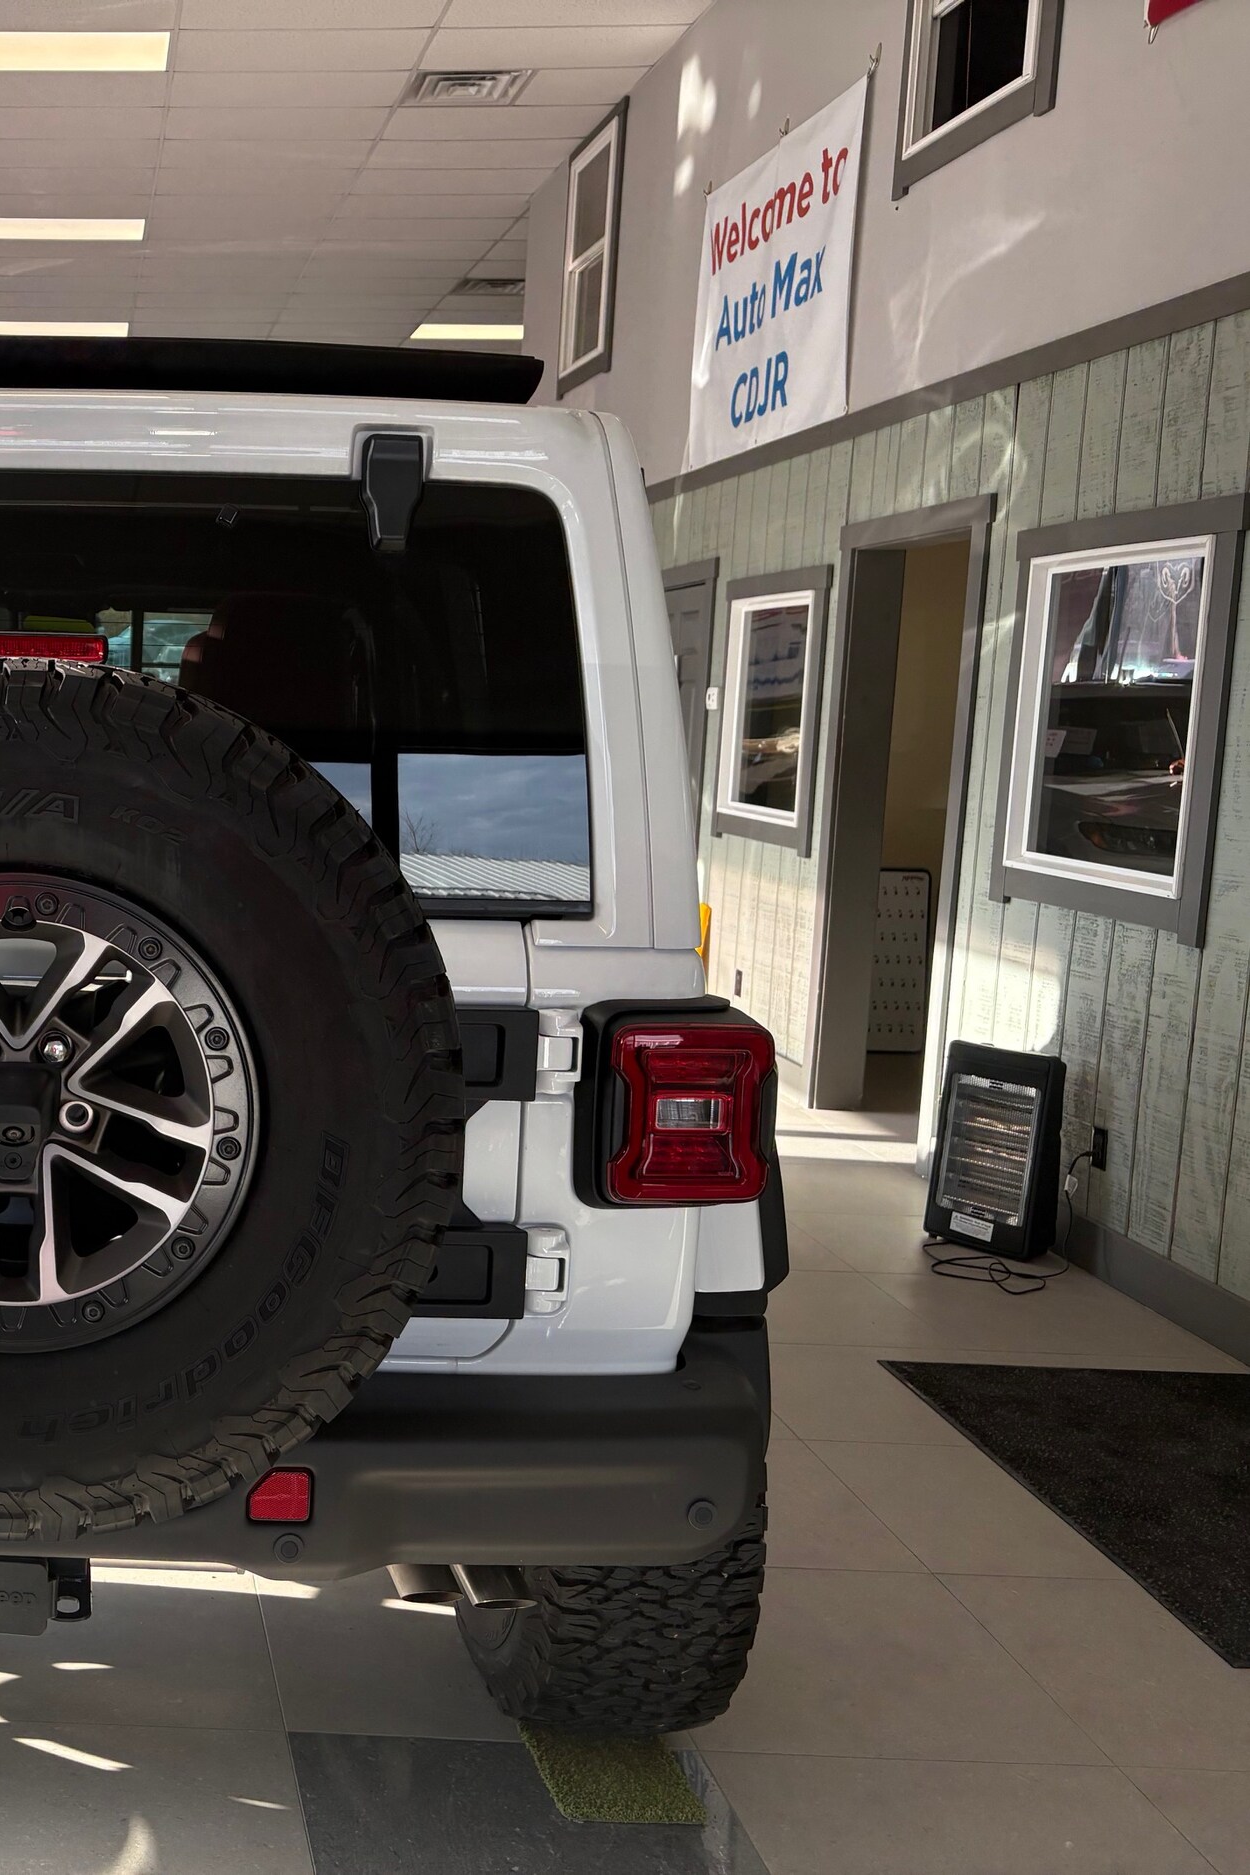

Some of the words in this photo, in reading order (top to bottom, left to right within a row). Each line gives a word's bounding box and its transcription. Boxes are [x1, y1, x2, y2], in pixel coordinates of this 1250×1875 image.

[710, 171, 815, 275] Welcome
[821, 146, 849, 205] to
[714, 283, 766, 351] Auto
[771, 245, 826, 320] Max
[730, 350, 789, 428] CDJR
[17, 1129, 350, 1446] BFGoodrich
